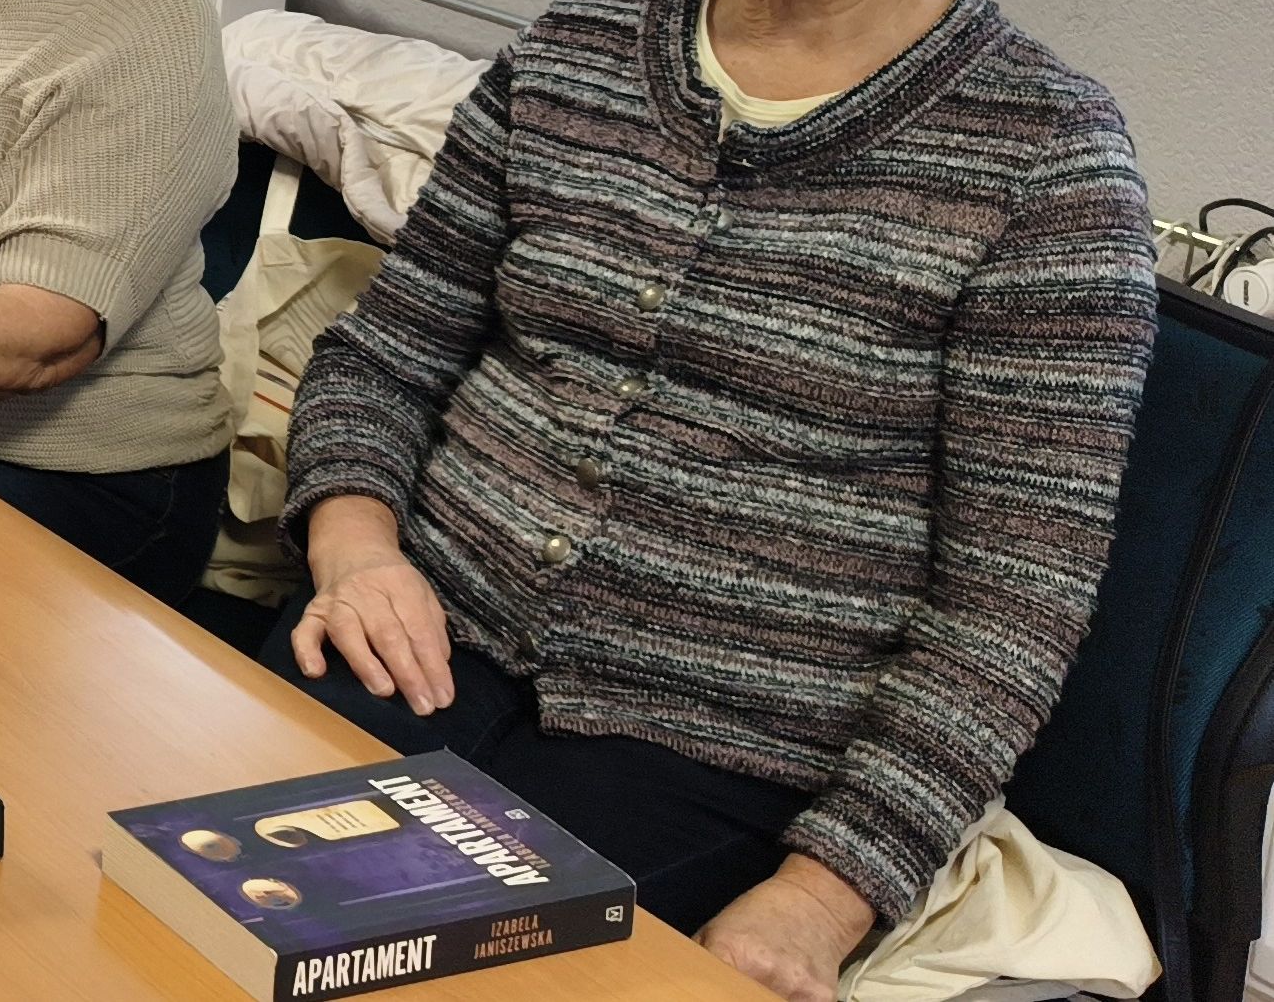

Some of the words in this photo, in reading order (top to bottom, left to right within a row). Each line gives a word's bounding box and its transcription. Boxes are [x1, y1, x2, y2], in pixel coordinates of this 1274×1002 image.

[367, 775, 551, 886] APARTAMENT
[473, 929, 553, 960] JANISZEWSKA
[490, 914, 539, 938] IZABELA
[292, 934, 437, 997] APARTAMENT
